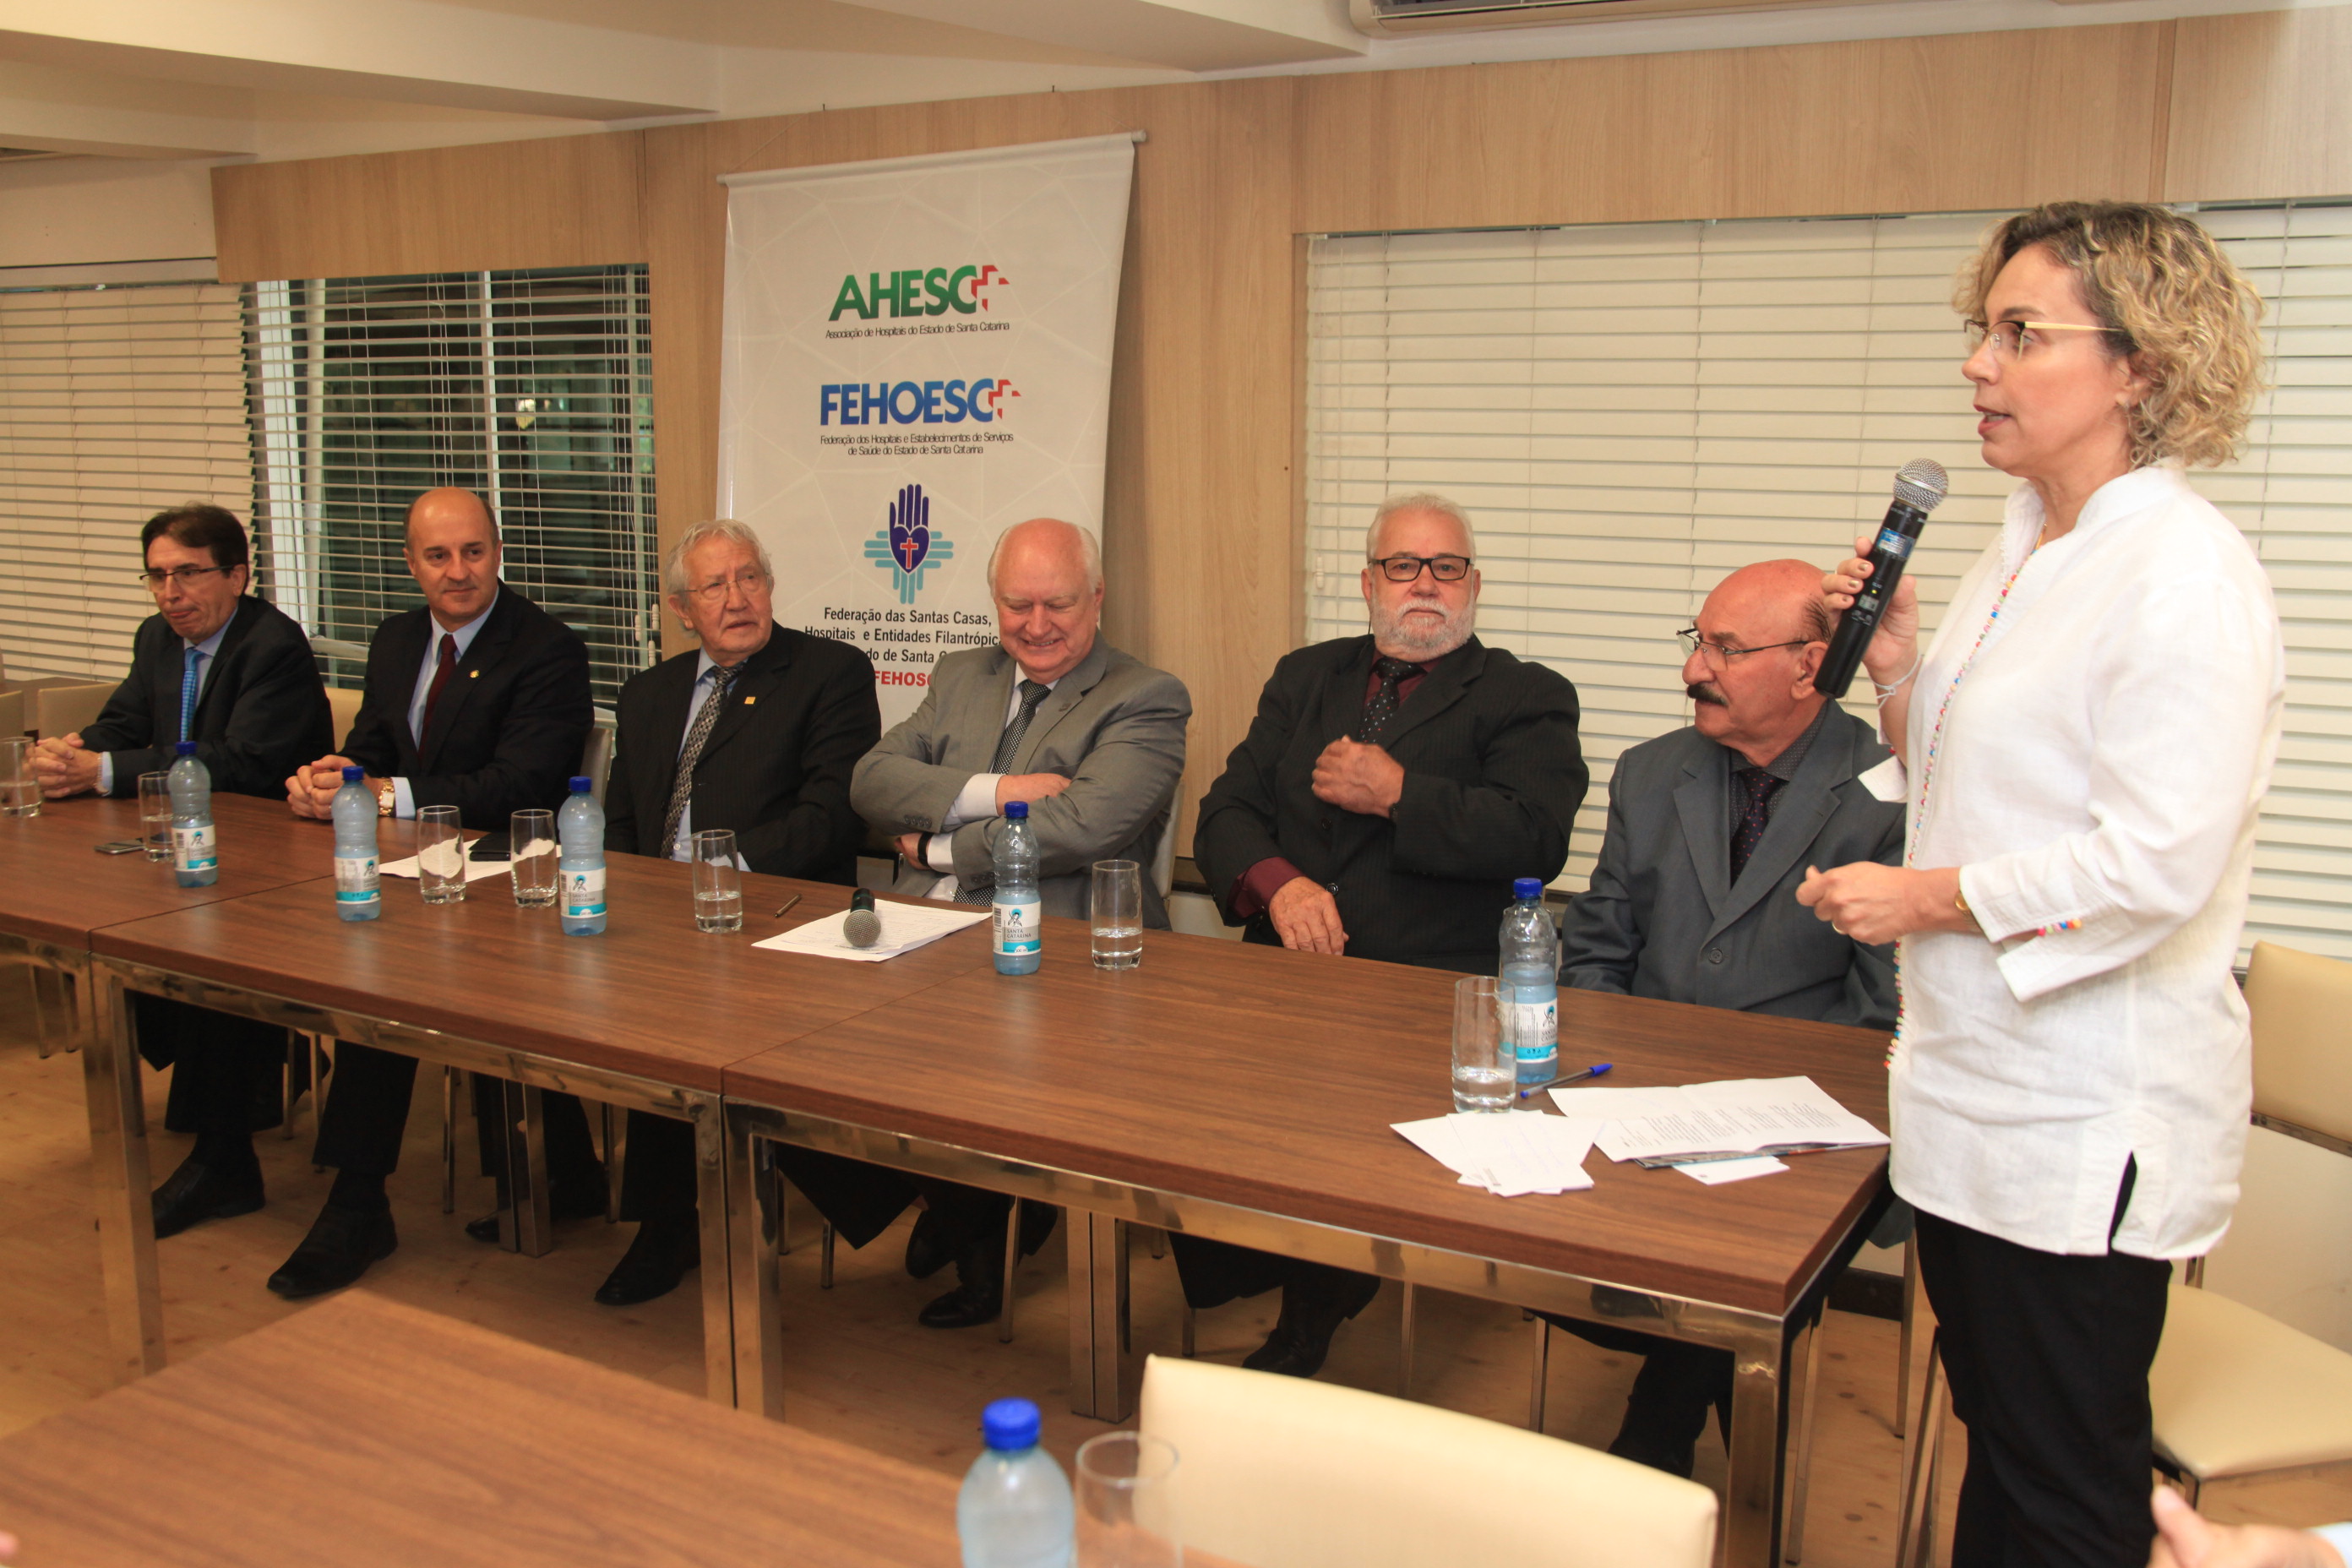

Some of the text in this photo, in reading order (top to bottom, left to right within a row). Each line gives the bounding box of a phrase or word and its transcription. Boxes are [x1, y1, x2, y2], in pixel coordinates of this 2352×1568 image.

[829, 264, 977, 321] AHESC
[825, 321, 1010, 340] Associação de Hospitais do Estado de Santa Catarina
[820, 378, 994, 426] FEHOESC
[820, 435, 855, 446] Federação
[857, 435, 869, 444] dos
[871, 434, 901, 445] Hospitais
[910, 433, 970, 443] Estabelecimentos
[972, 433, 982, 442] de
[983, 432, 1014, 444] Serviços
[848, 447, 857, 455] de
[858, 446, 881, 455] Saúde
[883, 446, 892, 455] do
[894, 445, 917, 455] Estado
[919, 446, 928, 455] de
[930, 445, 951, 455] Santa
[824, 607, 992, 628] Federação das Santas Casas,
[805, 626, 1001, 647] Hospitais e Entidades Filantrópic
[883, 649, 897, 662] de
[901, 649, 934, 663] Santa
